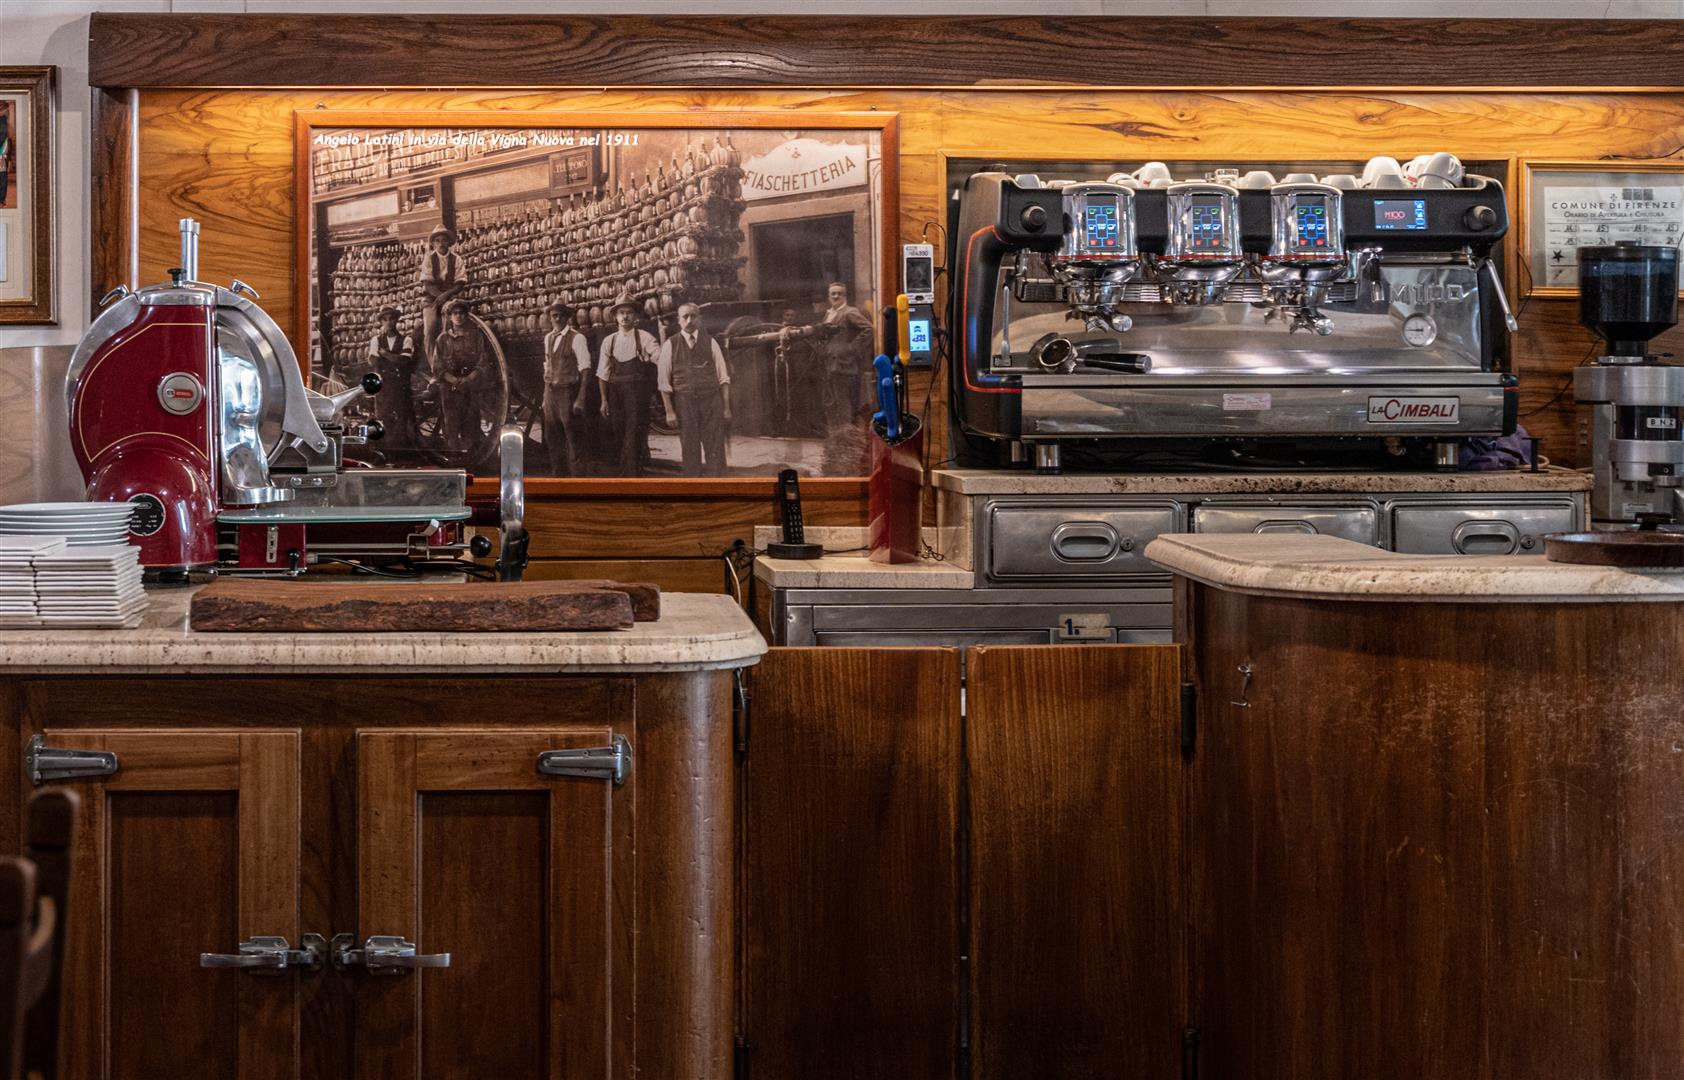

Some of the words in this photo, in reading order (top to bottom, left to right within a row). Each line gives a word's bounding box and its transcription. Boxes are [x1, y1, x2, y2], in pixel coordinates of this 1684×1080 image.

[314, 133, 360, 148] Angelo
[365, 133, 404, 145] Latini
[410, 133, 422, 145] in
[428, 133, 447, 145] via
[452, 133, 485, 146] della
[491, 133, 527, 149] Vigna
[532, 133, 574, 146] Nuova
[580, 133, 600, 146] nel
[606, 133, 639, 146] 1911
[743, 156, 857, 192] FIASCHETTERIA
[1552, 202, 1604, 210] COMUNE
[1609, 202, 1621, 210] DI
[1625, 201, 1677, 209] FIRENZE
[1384, 210, 1406, 220] M100
[1372, 406, 1384, 414] LA
[1384, 399, 1456, 420] CIMBALI
